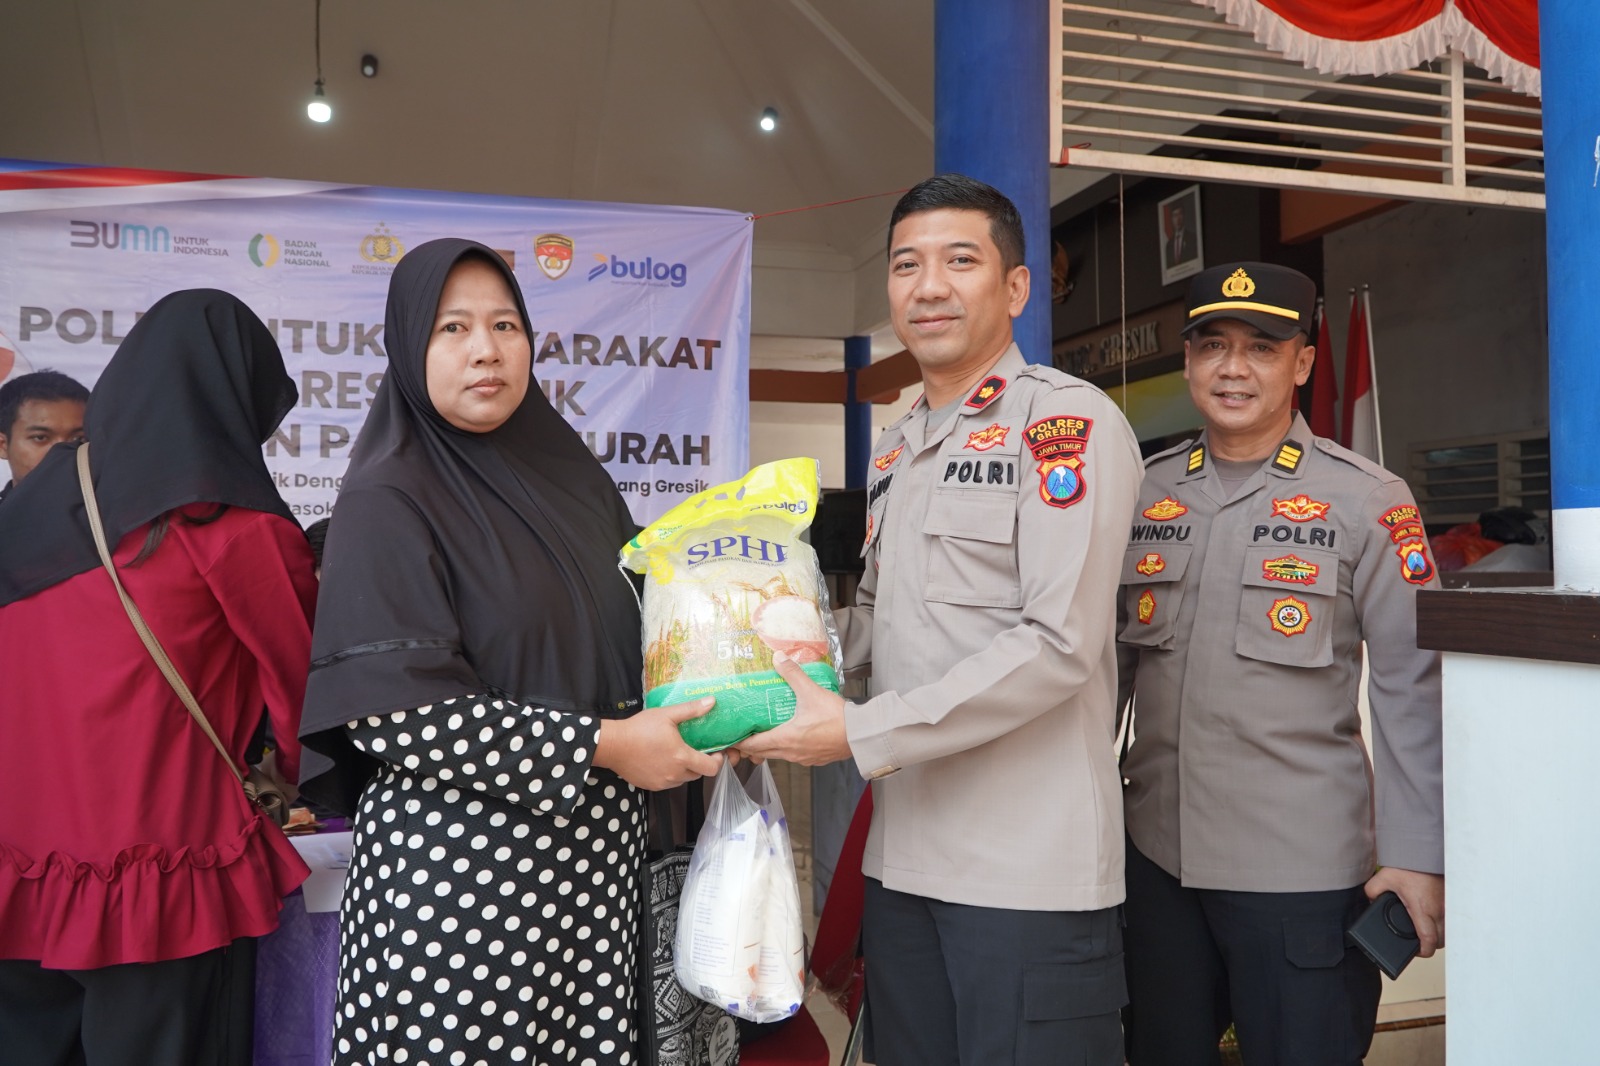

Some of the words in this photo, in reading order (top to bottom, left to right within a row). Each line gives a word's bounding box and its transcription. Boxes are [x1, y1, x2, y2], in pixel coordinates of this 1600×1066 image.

[173, 236, 209, 246] UNTUK
[284, 239, 317, 248] BADAN
[173, 246, 229, 257] INDONESIA
[284, 248, 323, 258] PANGAN
[284, 258, 331, 268] NASIONAL
[611, 254, 687, 288] bulog
[19, 305, 145, 345] POL
[268, 318, 387, 357] TUK
[533, 331, 721, 371] ARAKAT
[1028, 418, 1085, 438] POLRES
[1037, 428, 1078, 441] GRESIK
[576, 431, 711, 466] URAH
[1037, 444, 1058, 456] JAWA
[943, 460, 1014, 485] POLRI
[294, 473, 342, 492] Deng
[1131, 524, 1191, 541] WINDU
[1253, 524, 1336, 548] POLRI
[717, 640, 733, 660] 5
[734, 639, 754, 659] kg
[684, 686, 724, 697] Cadangan
